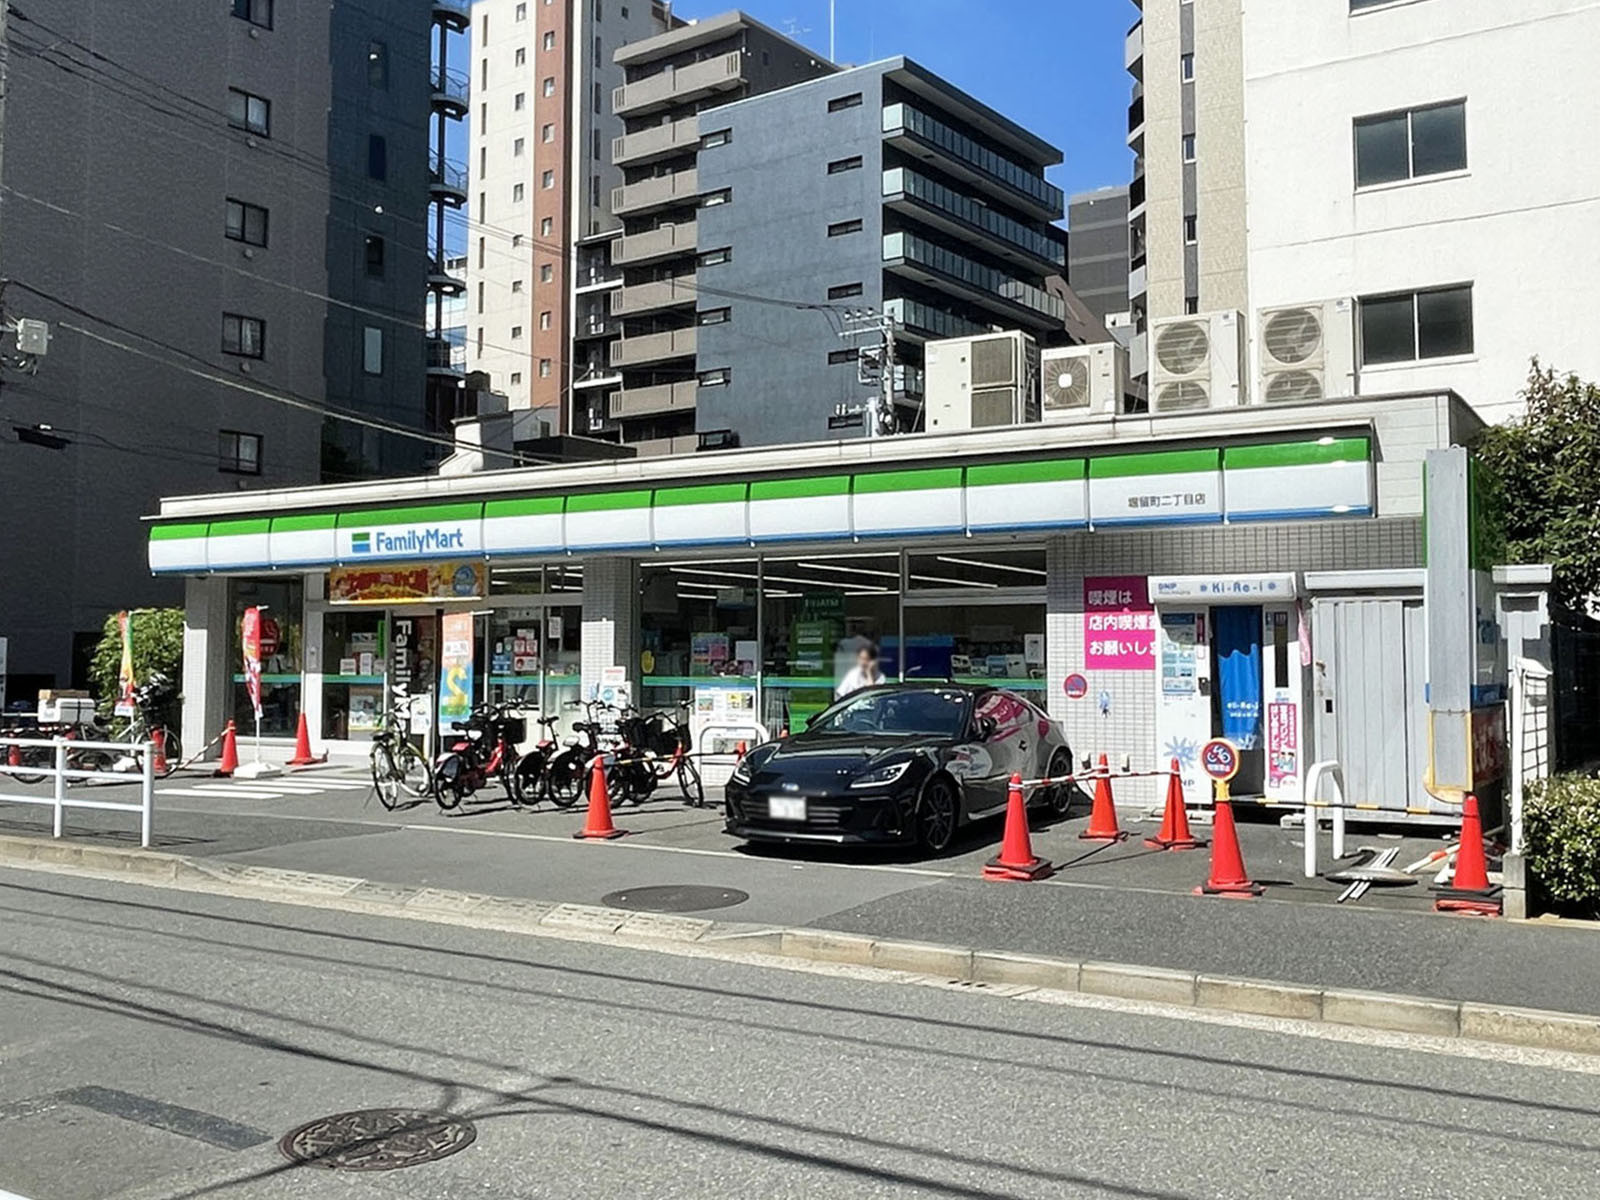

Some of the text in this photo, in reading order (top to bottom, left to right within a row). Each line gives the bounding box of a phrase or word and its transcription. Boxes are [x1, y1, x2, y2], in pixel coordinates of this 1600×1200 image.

[376, 528, 464, 553] FamilyMart
[1087, 590, 1133, 606] 喫煙は
